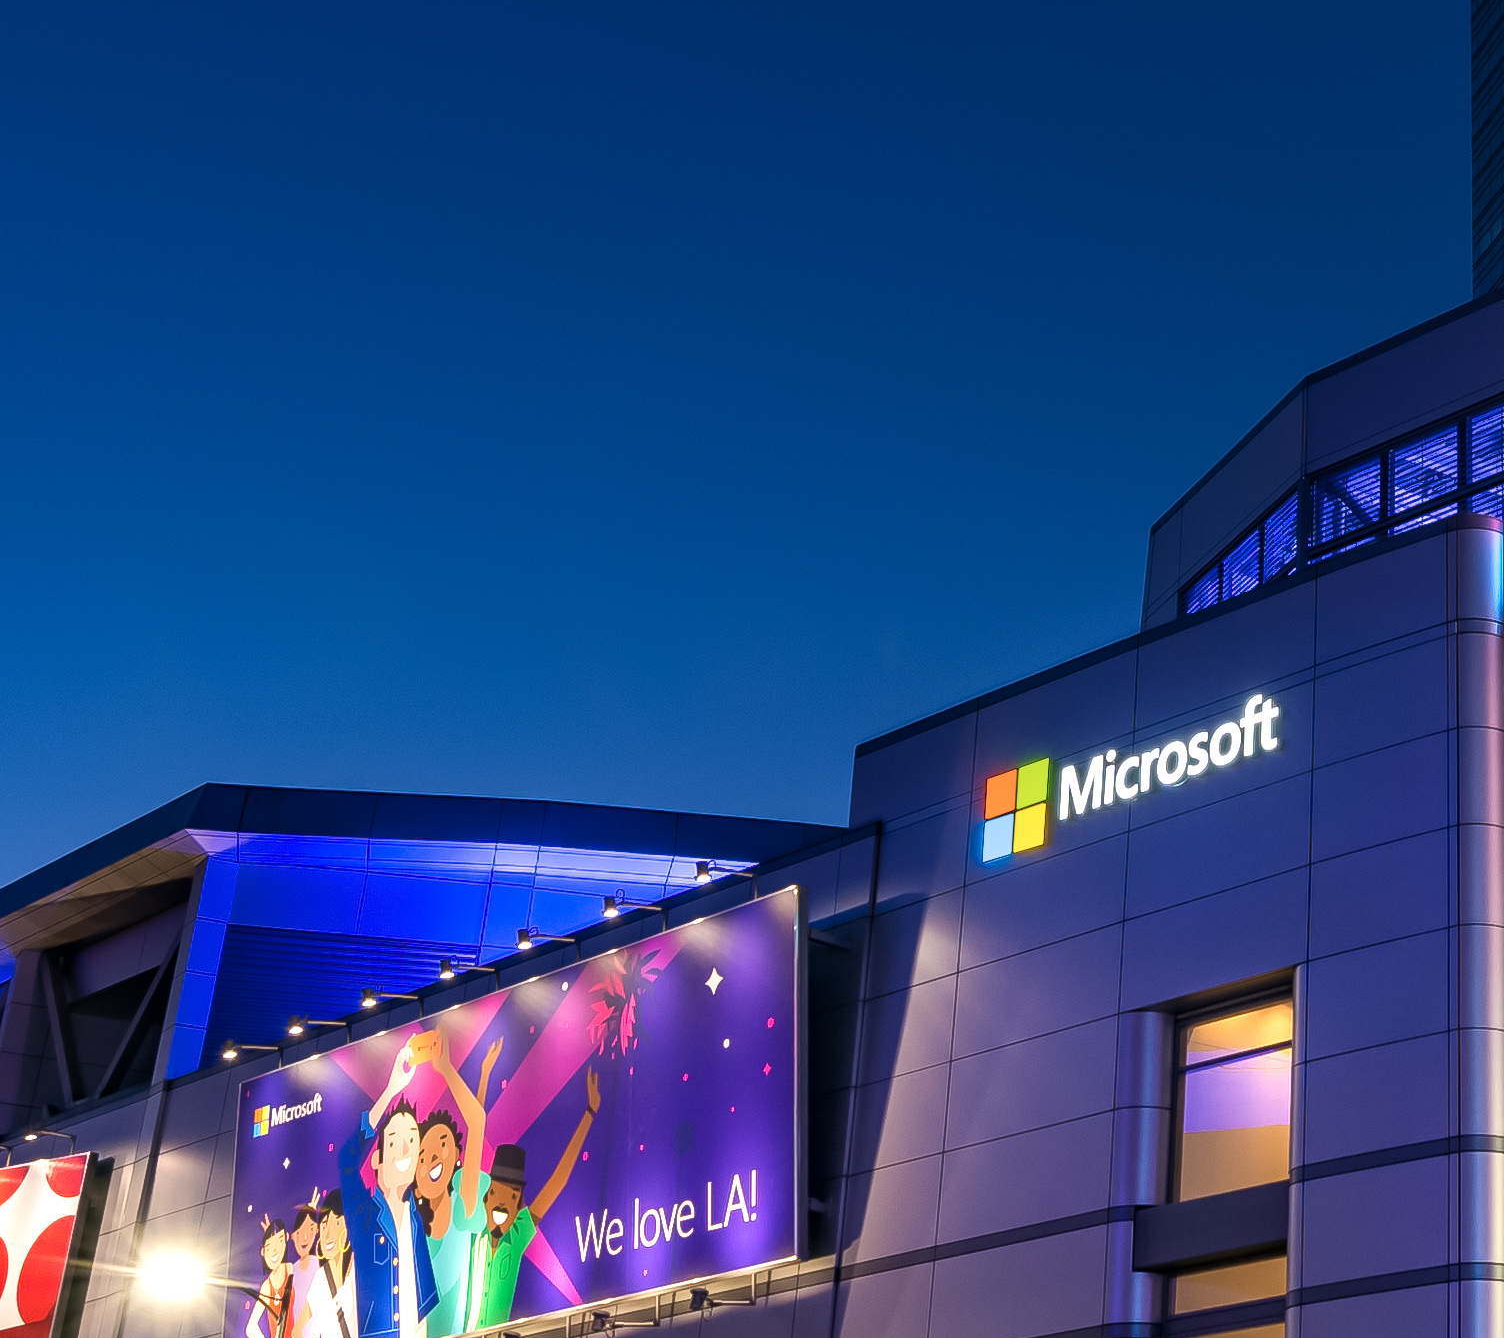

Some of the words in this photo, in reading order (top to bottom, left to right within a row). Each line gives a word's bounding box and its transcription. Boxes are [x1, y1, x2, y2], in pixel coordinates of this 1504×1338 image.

[1058, 694, 1280, 821] Microsoft
[270, 1092, 323, 1128] Microsoft
[575, 1209, 624, 1263] We
[633, 1197, 695, 1250] love
[707, 1169, 757, 1232] LA!
